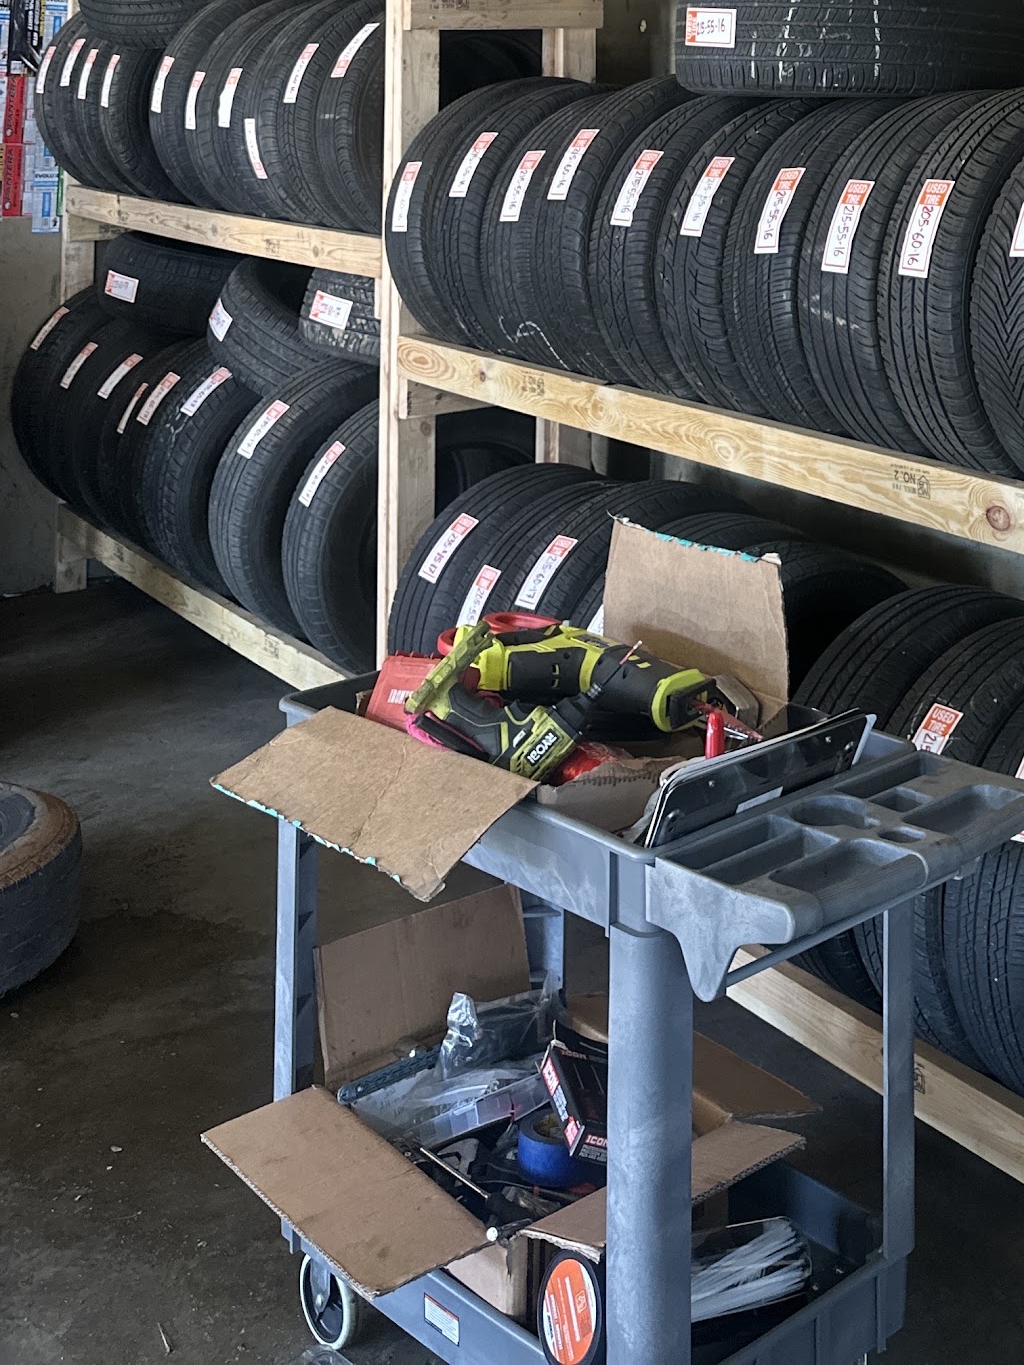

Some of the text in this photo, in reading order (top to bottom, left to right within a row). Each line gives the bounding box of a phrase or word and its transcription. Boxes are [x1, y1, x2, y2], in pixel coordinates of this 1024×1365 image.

[781, 170, 798, 181] USED
[778, 180, 792, 190] TIRE
[848, 183, 867, 194] USED
[926, 184, 946, 194] USED
[845, 194, 860, 204] TIRE
[924, 194, 941, 205] TIRE
[763, 190, 787, 240] 215-55-16
[833, 205, 854, 258] 215-55-16
[907, 205, 934, 267] 205-60-16
[932, 707, 956, 724] USED
[927, 719, 948, 735] TIRE
[527, 732, 558, 764] RYOBI
